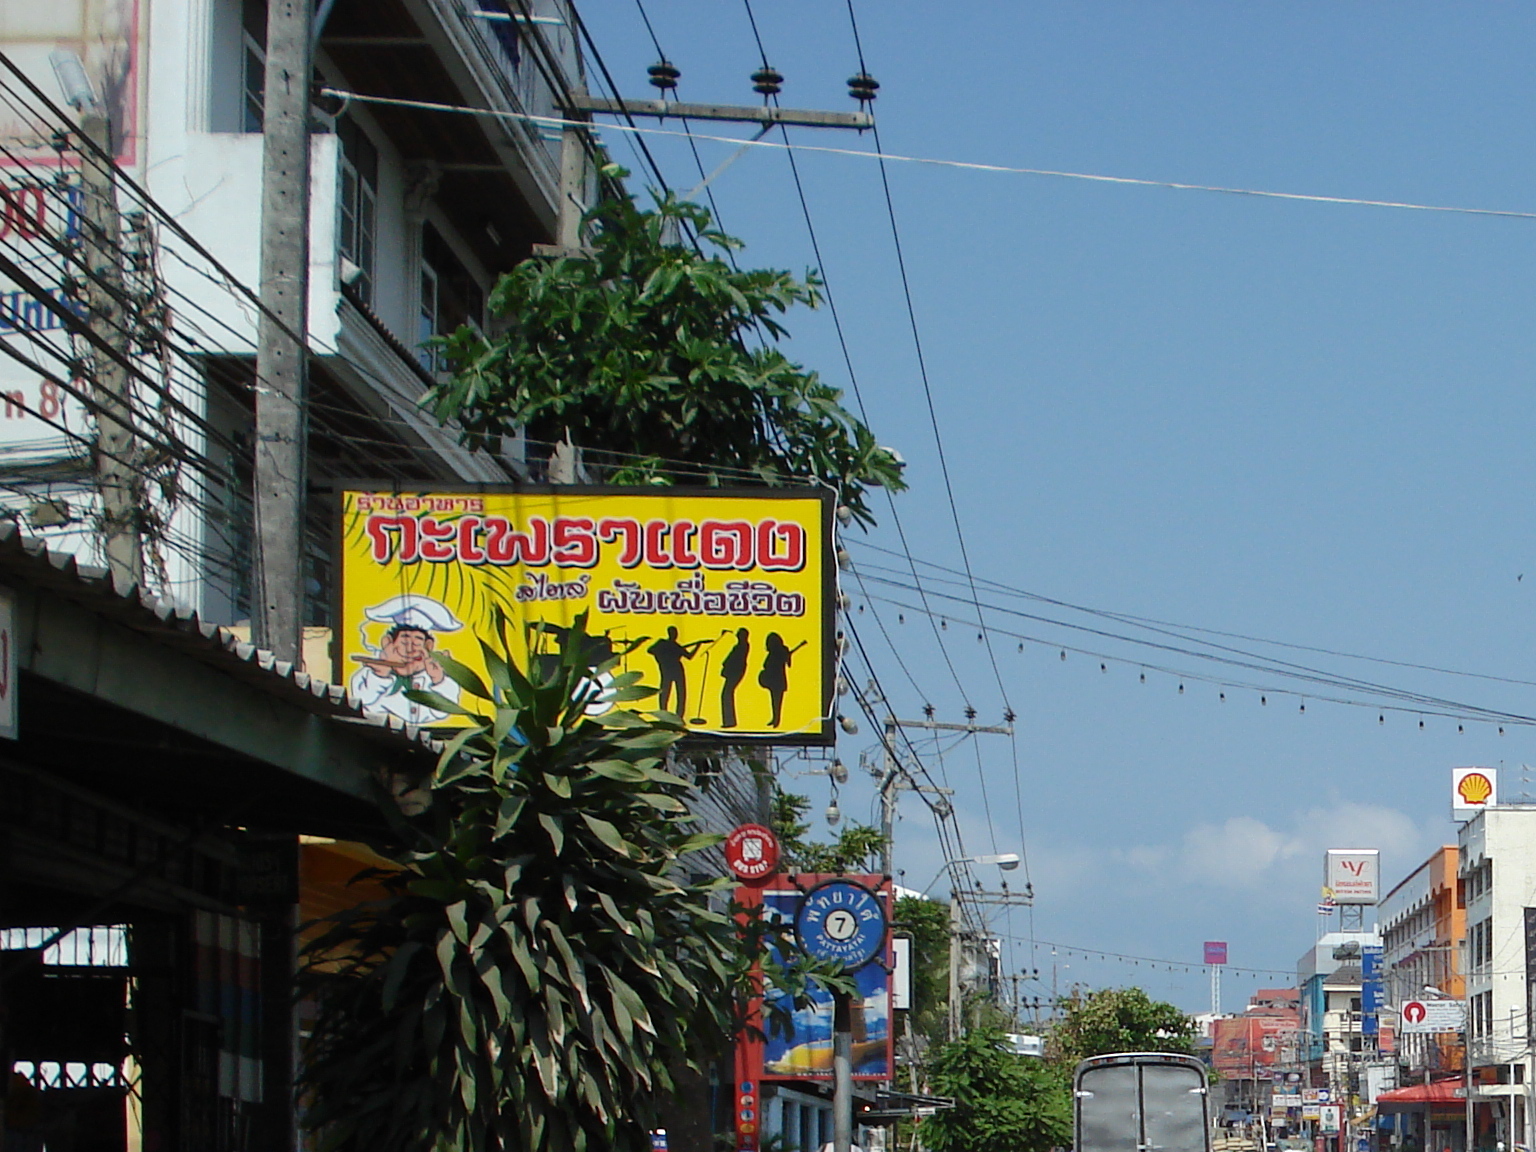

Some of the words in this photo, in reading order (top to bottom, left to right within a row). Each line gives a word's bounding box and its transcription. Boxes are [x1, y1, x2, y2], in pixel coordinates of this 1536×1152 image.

[357, 491, 485, 513] ร้านอาหาร
[365, 514, 806, 572] กะเพราแดง
[598, 572, 806, 616] ผับเพื่อชีวิต
[804, 890, 881, 922] พัทยาใต้
[834, 917, 846, 933] 7
